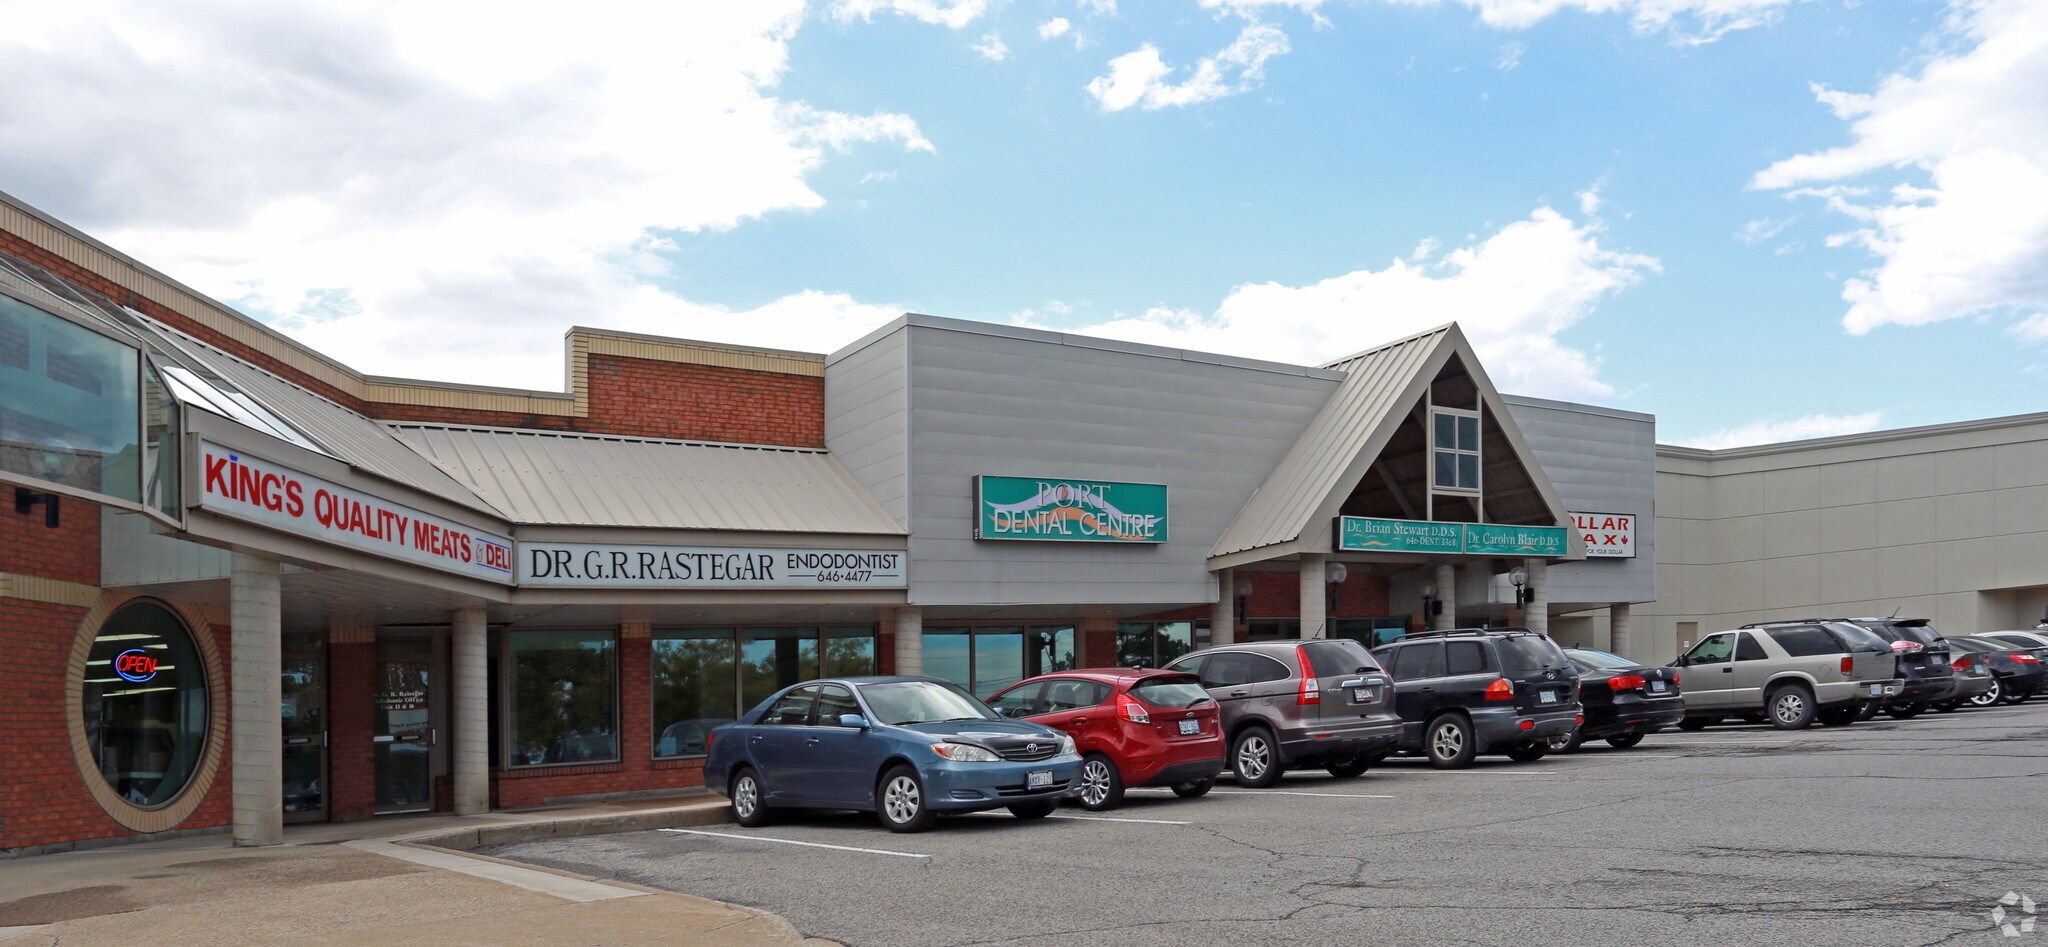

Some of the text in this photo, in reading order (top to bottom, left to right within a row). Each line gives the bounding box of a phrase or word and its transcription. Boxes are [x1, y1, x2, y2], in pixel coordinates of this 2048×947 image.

[1036, 481, 1112, 509] PORT
[205, 452, 511, 570] KING'S QUALITY MEATS & DELI
[994, 509, 1072, 535] DENTAL
[1080, 512, 1156, 537] CENTRE
[1347, 519, 1361, 532] Dr.
[1365, 520, 1391, 534] Brian
[1394, 521, 1429, 536] Stewart
[1483, 532, 1516, 548] Carolyn
[1518, 533, 1539, 546] Blair
[787, 553, 899, 570] ENDODONTIST
[117, 654, 157, 673] OPEN
